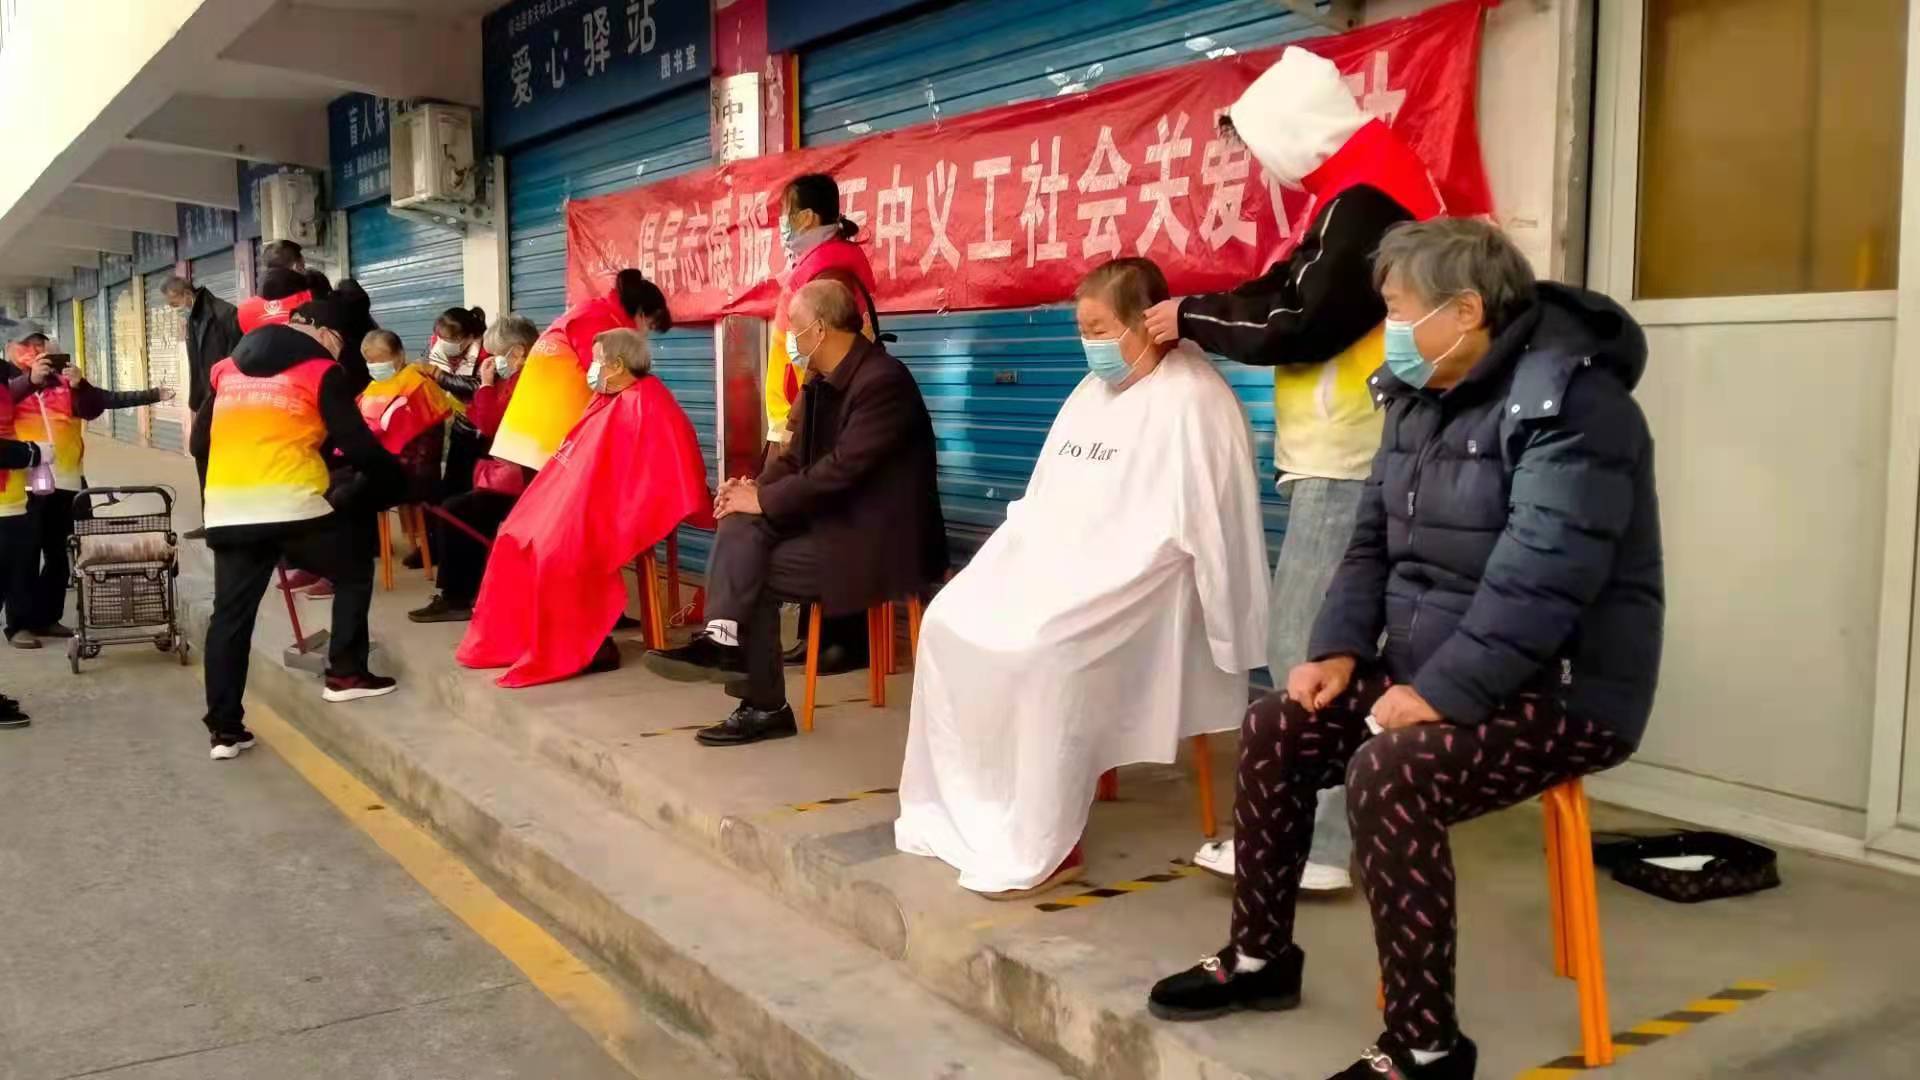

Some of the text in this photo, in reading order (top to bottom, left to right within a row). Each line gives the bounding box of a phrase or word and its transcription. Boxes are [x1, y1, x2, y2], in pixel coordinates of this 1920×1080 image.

[510, 0, 657, 108] 爱心驿站
[660, 43, 697, 80] 图书室
